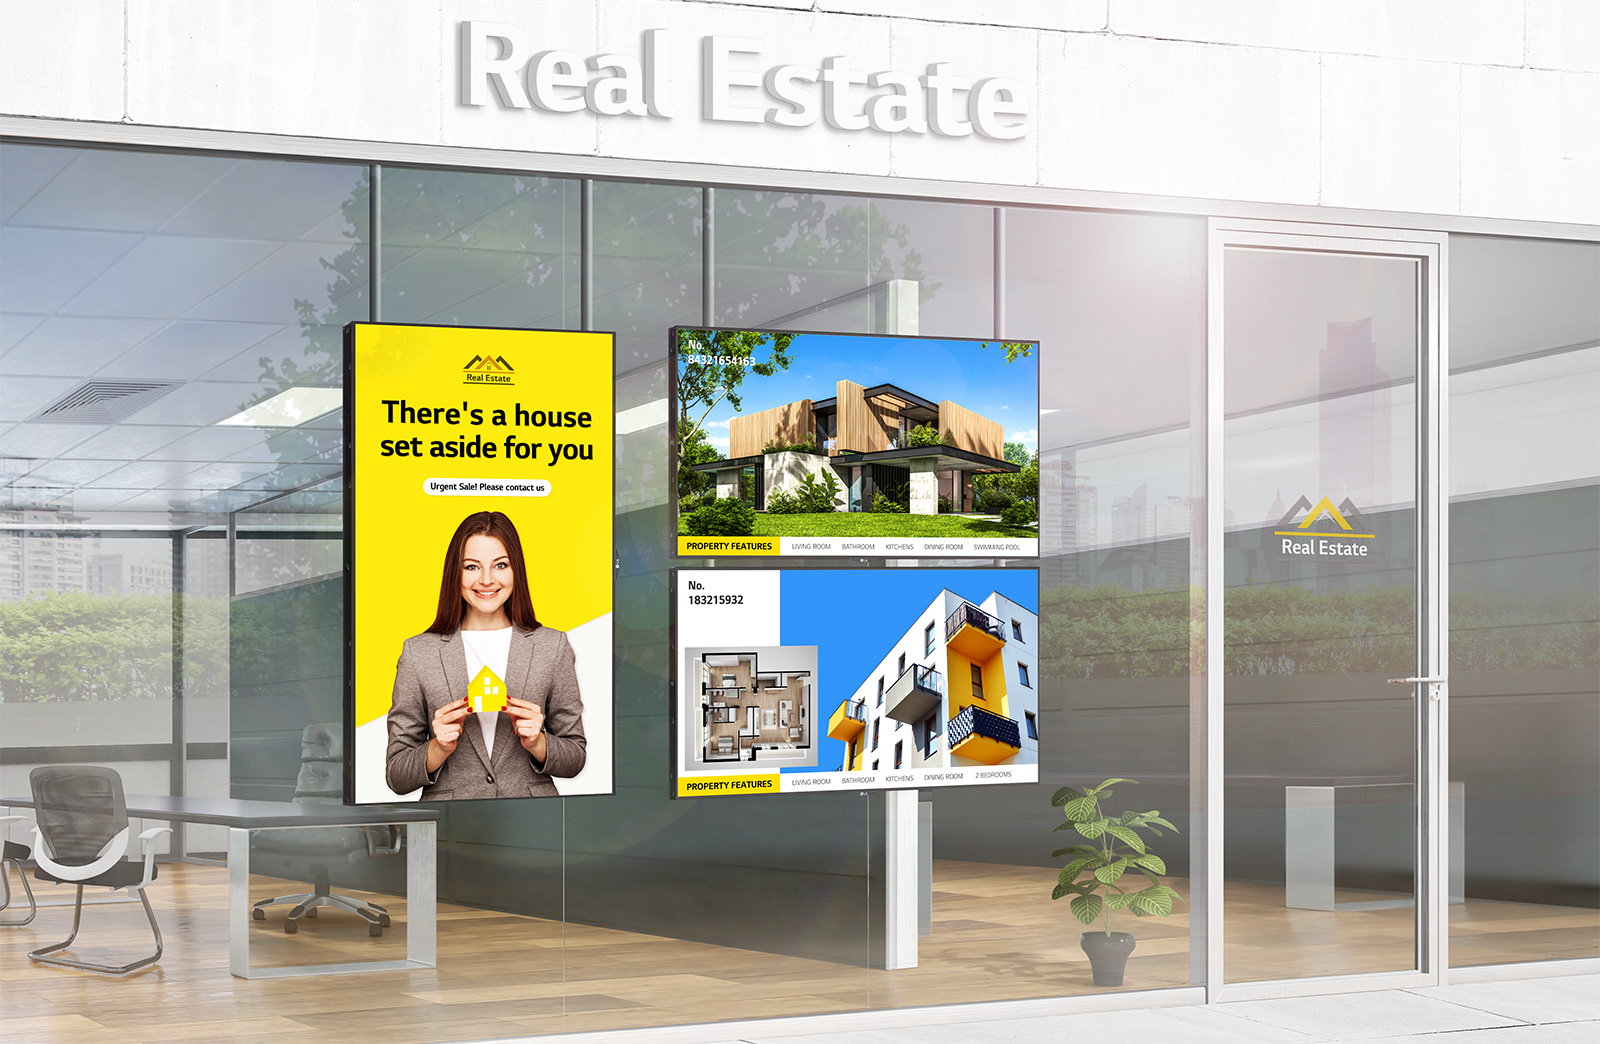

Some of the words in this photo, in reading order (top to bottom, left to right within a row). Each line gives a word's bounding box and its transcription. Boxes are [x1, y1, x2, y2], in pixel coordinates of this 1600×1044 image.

[460, 20, 676, 118] Real
[703, 35, 1029, 139] Estate
[689, 340, 704, 349] No.
[688, 354, 756, 366] 84321654163
[466, 373, 484, 382] Real
[485, 374, 511, 383] Estate
[382, 400, 483, 425] There's
[492, 410, 507, 426] a
[516, 403, 591, 428] house
[381, 437, 423, 457] set
[430, 435, 496, 458] aside
[504, 435, 542, 459] for
[548, 444, 593, 466] you
[430, 482, 458, 493] Urgent
[458, 482, 478, 491] Sale!
[479, 482, 504, 492] Please
[505, 484, 534, 492] contact
[686, 541, 730, 551] PROPERTY
[731, 542, 773, 551] FEATURES
[885, 543, 914, 551] KITCHENS
[924, 543, 945, 551] DINING
[945, 543, 964, 551] ROOM
[973, 543, 1005, 551] SWIMMING
[1005, 543, 1021, 551] POOL
[1282, 538, 1315, 555] Real
[1319, 539, 1368, 557] Estate
[689, 581, 704, 590] No.
[688, 594, 744, 605] 183215932
[885, 774, 915, 782] KITCHENS
[924, 773, 945, 781] DINING
[980, 771, 1012, 779] BEDROOMS
[686, 781, 730, 791] PROPERTY
[731, 779, 773, 789] FEATURES
[791, 778, 812, 786] LIVING
[812, 778, 831, 786] ROOM
[841, 776, 876, 785] BATHROOM
